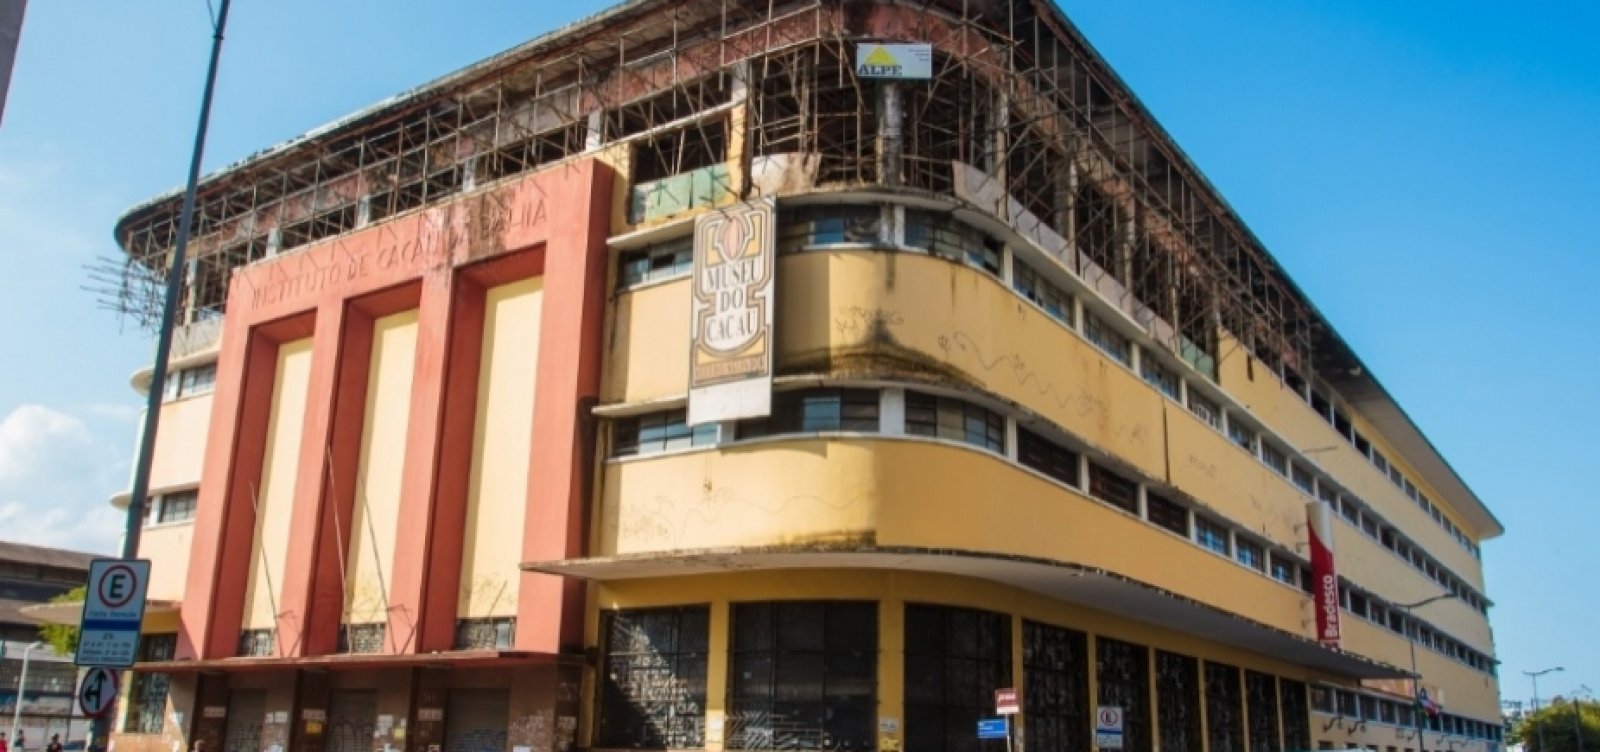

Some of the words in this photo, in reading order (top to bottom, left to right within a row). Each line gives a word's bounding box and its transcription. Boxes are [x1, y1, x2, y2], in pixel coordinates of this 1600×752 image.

[859, 64, 902, 75] ALPE
[348, 253, 370, 281] DE
[707, 261, 761, 290] MUSEU
[720, 289, 745, 312] DO
[706, 313, 756, 341] CACAU
[109, 574, 126, 598] E
[1323, 575, 1338, 638] Bradesco
